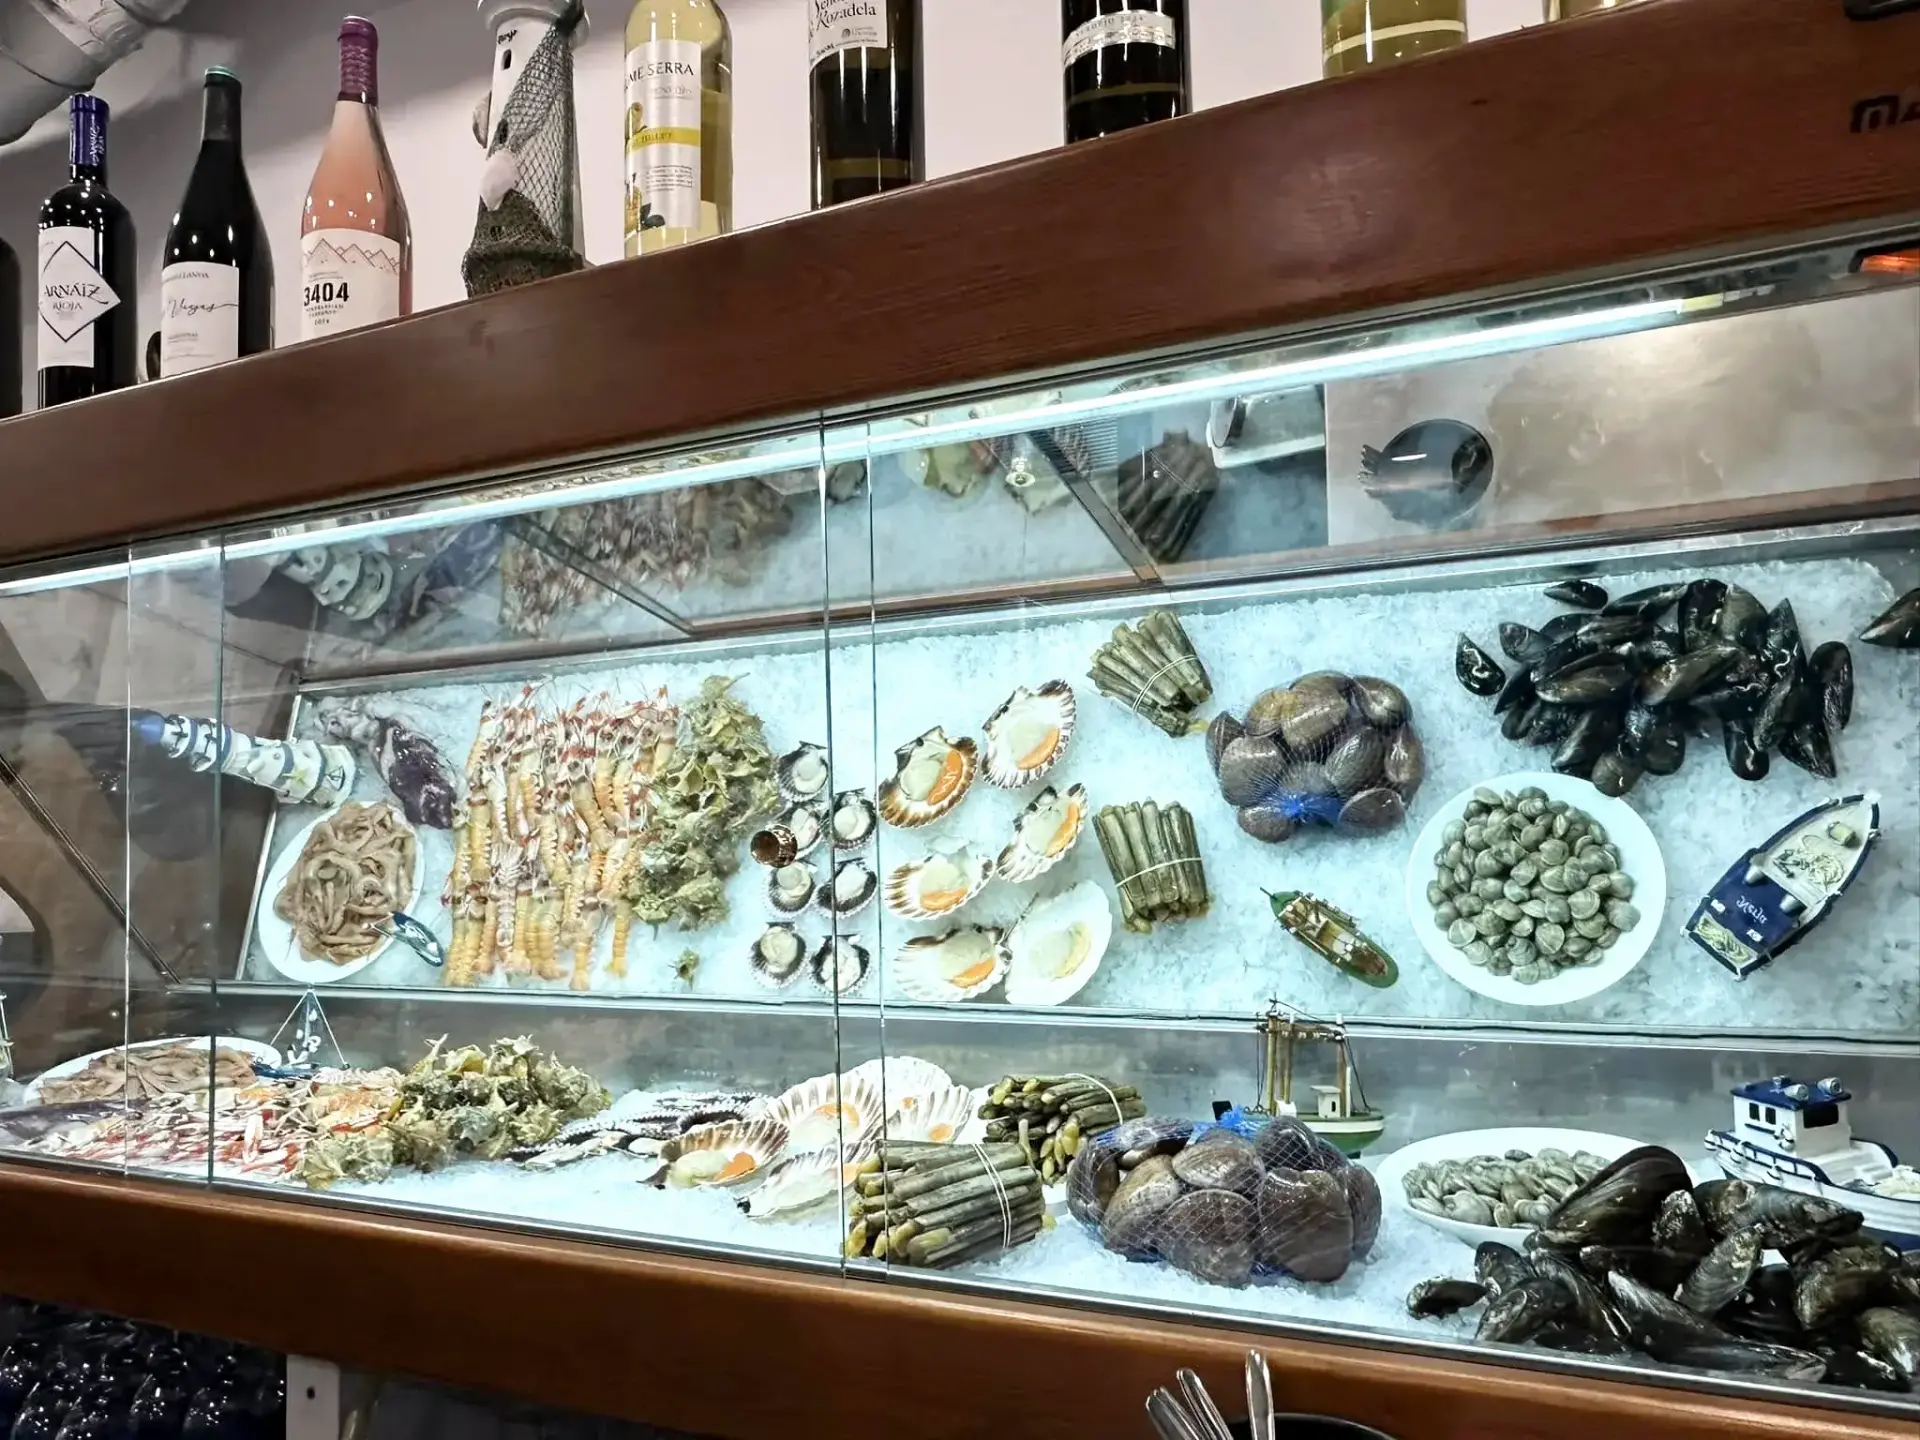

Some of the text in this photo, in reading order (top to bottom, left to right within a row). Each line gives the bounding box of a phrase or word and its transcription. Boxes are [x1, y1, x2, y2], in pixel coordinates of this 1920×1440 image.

[647, 61, 694, 77] SERRA
[303, 282, 350, 306] 3404
[52, 300, 83, 311] RIOJA
